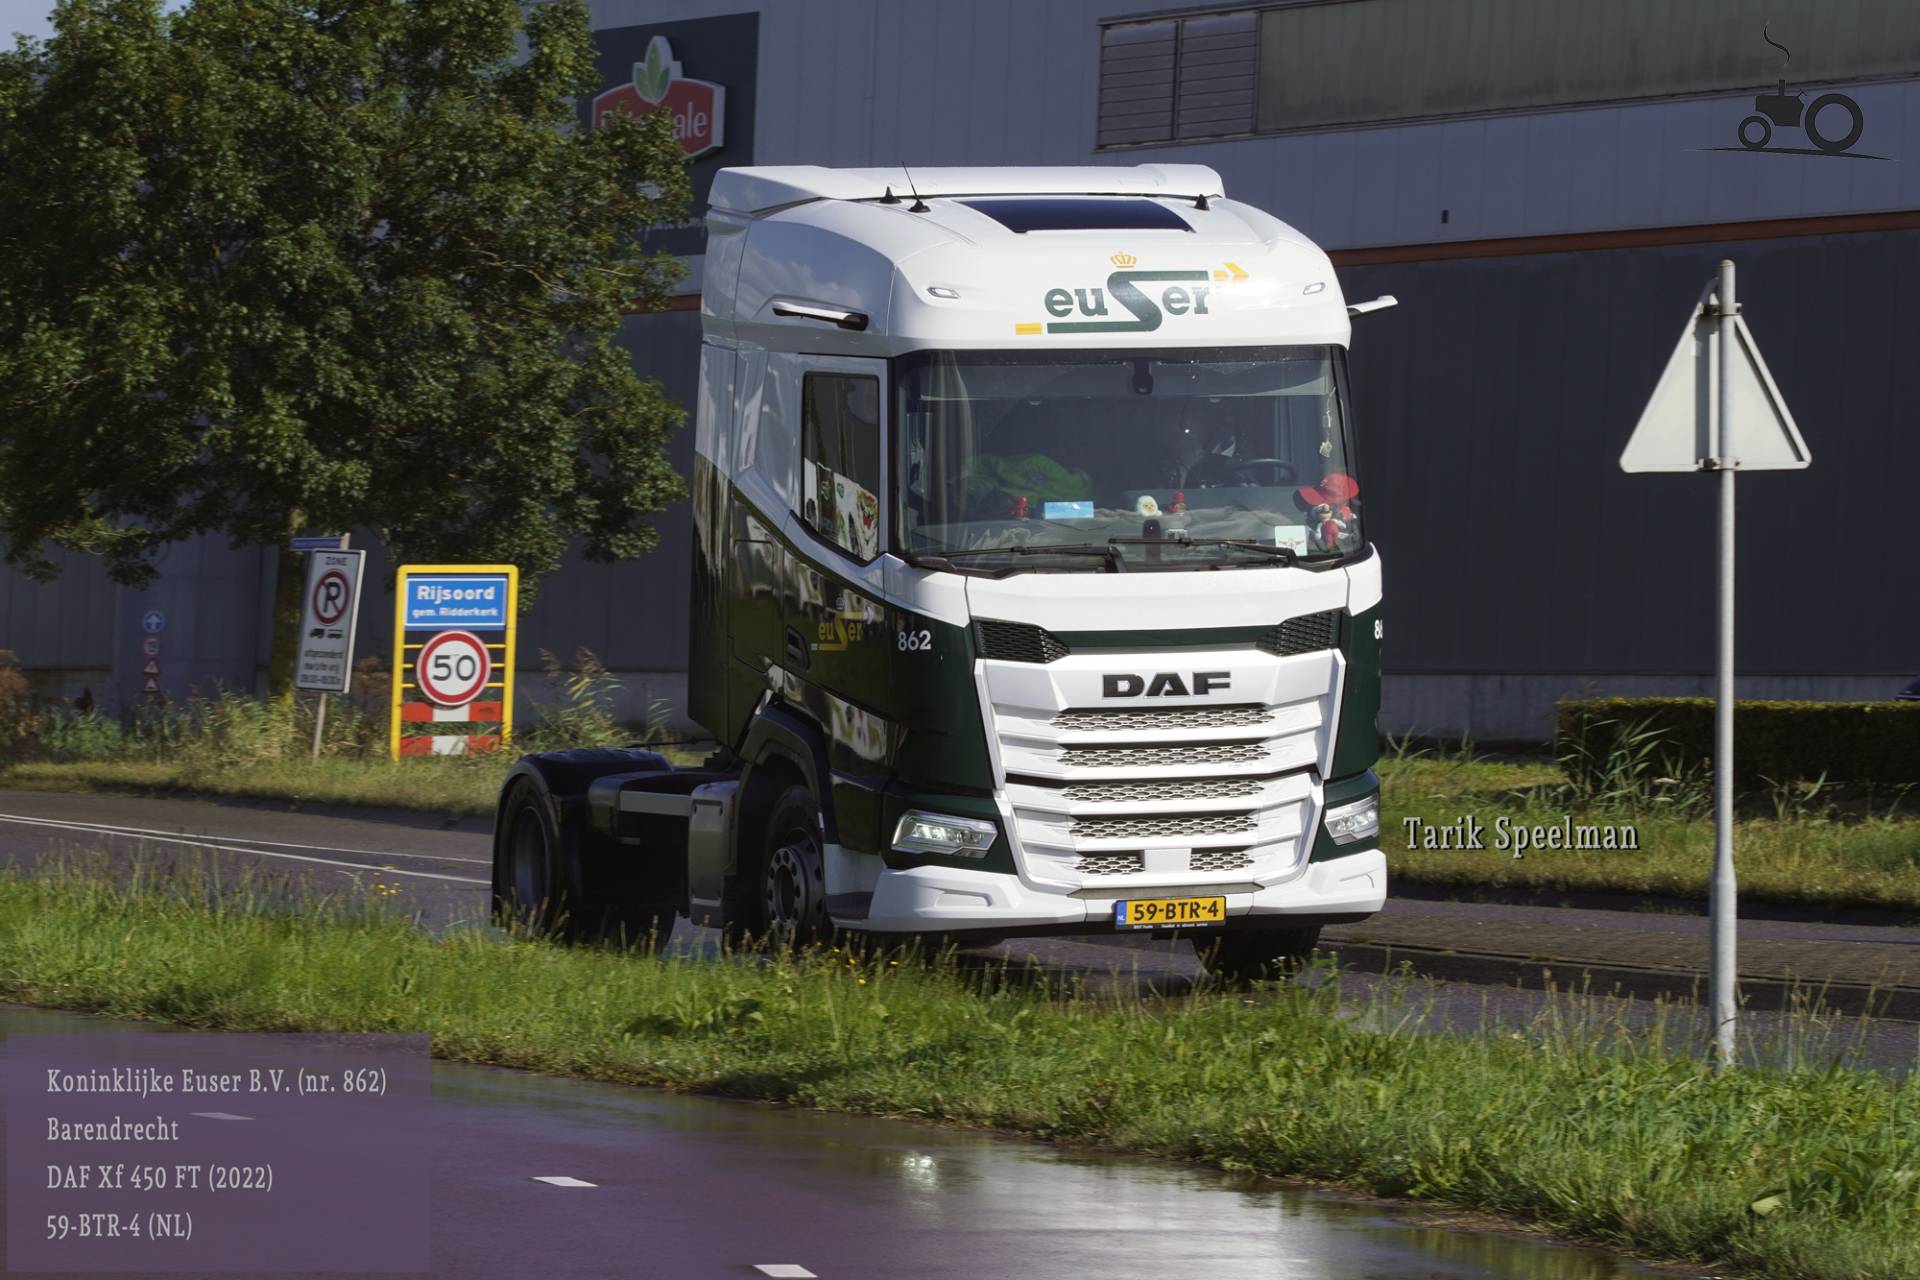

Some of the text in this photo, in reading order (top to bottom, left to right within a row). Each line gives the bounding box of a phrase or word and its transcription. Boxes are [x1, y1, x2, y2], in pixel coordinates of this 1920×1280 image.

[417, 585, 496, 605] Rijsoord
[412, 607, 498, 619] gem. Ridderkerk
[898, 630, 932, 651] 862
[432, 654, 476, 681] 50
[1102, 671, 1231, 698] DAF
[1133, 900, 1219, 921] 59-BTR-4
